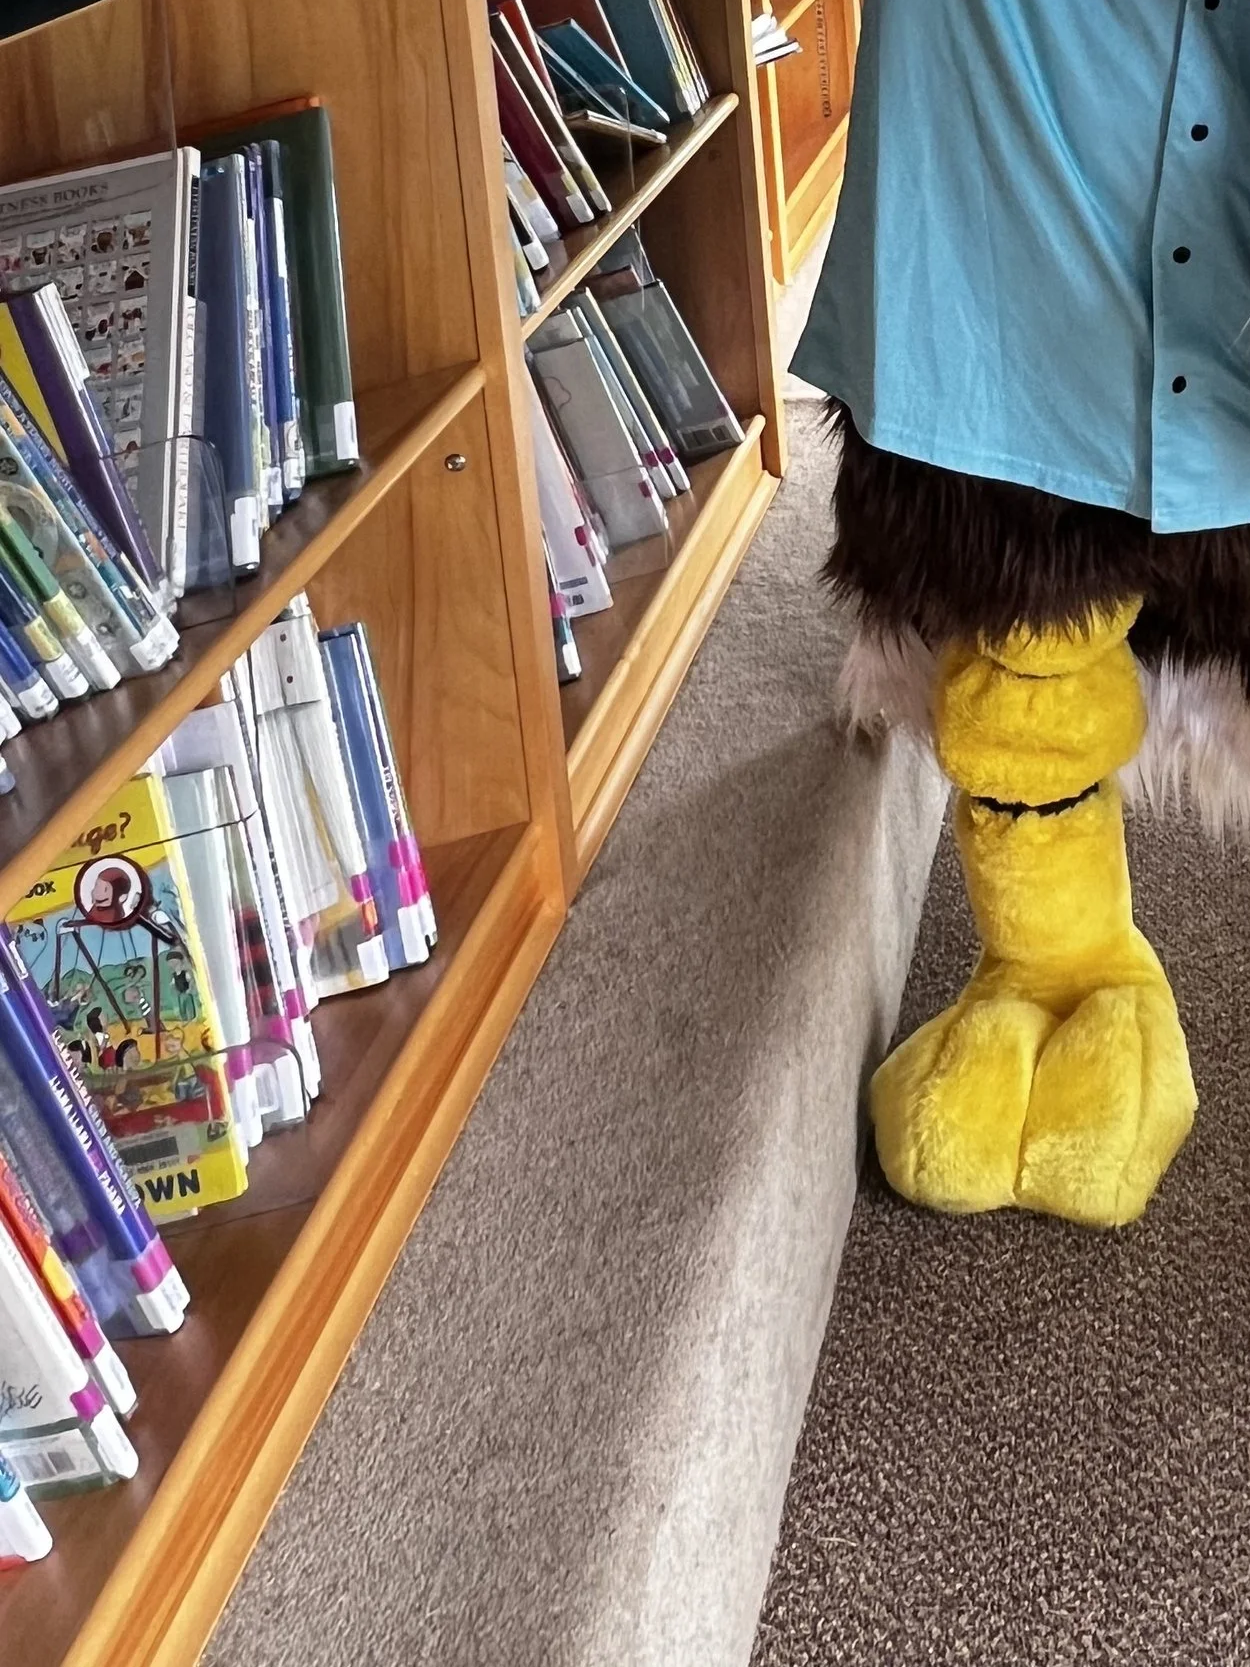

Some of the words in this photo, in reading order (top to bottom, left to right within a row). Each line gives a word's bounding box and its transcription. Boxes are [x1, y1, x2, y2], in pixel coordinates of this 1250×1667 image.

[52, 1029, 73, 1070] LLAMA
[70, 1067, 92, 1107] LLAMA
[49, 1075, 74, 1113] LLAMA
[69, 1111, 93, 1151] LLAMA
